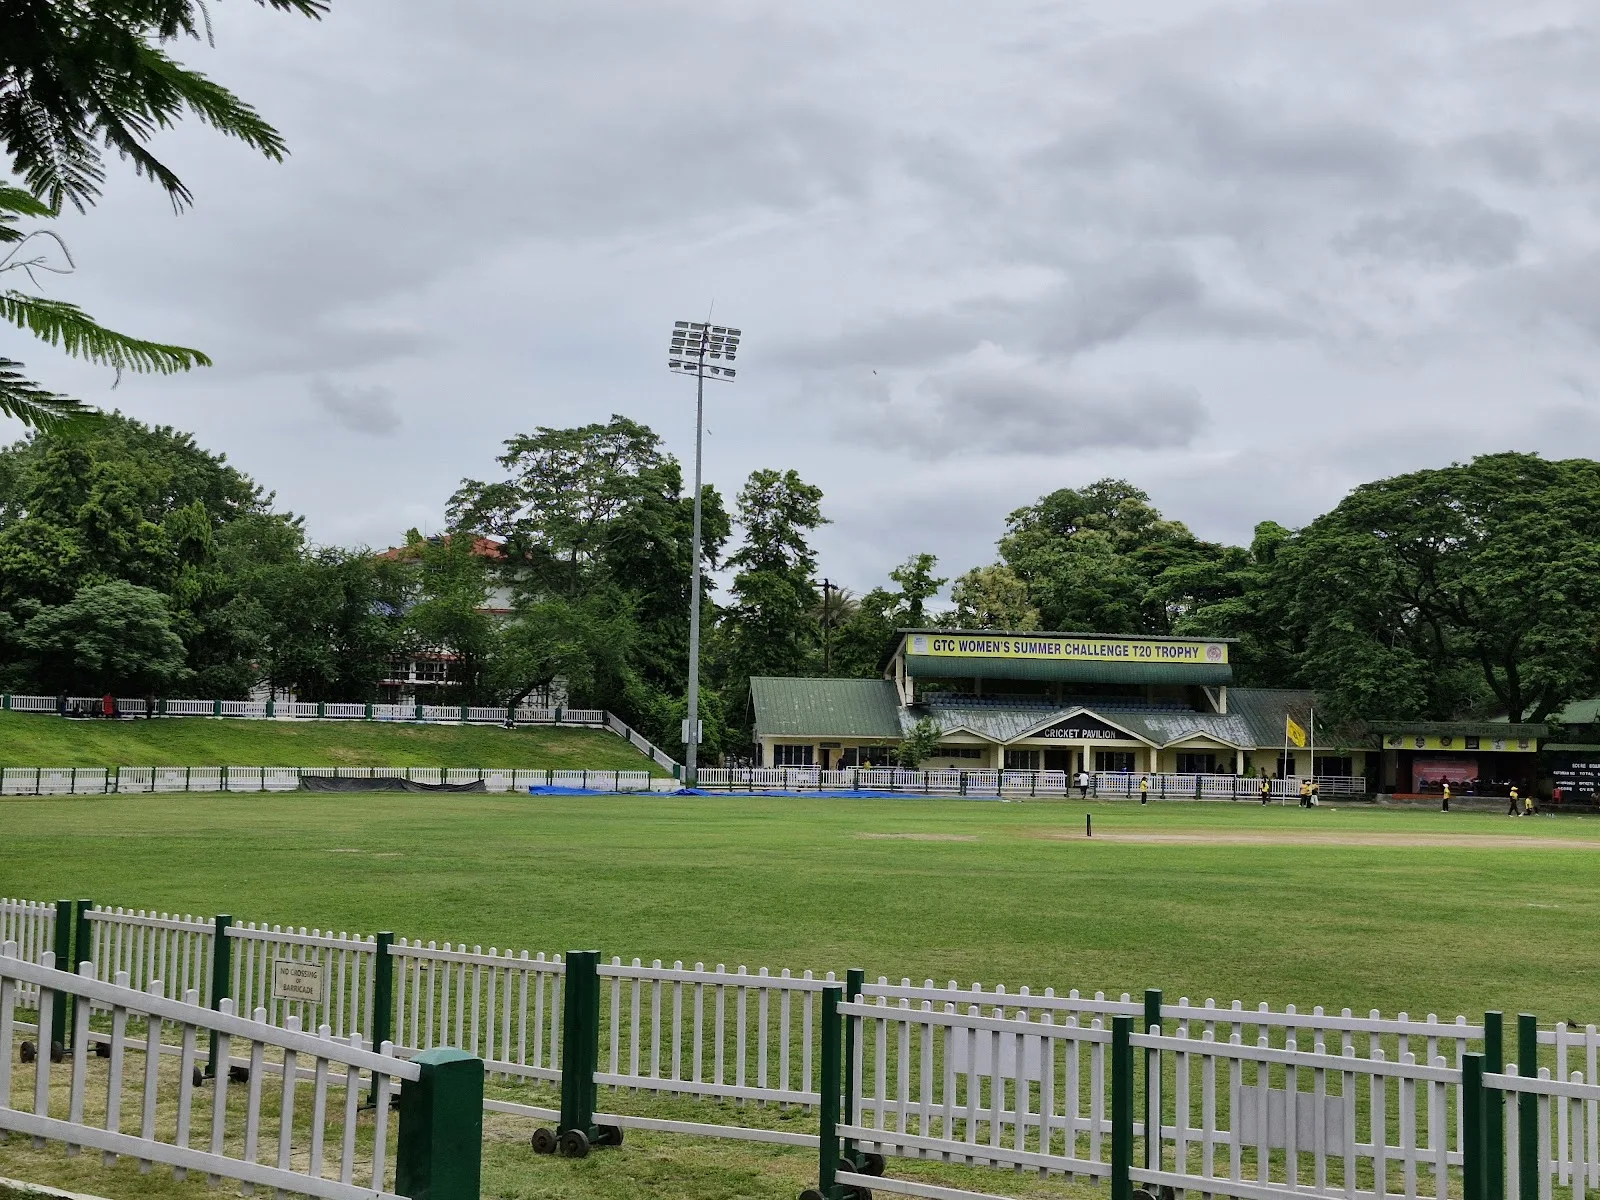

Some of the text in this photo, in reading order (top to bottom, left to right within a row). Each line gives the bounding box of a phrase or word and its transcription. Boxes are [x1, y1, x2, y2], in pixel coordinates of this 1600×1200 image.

[933, 639, 955, 652] GTC
[959, 640, 1010, 653] WOMEN'S
[1013, 641, 1061, 655] SUMMER
[1064, 643, 1129, 657] CHALLENGE
[1132, 645, 1152, 658] T20
[1154, 645, 1199, 659] TROPHY
[1044, 728, 1116, 738] CRICKET PAVILION
[290, 969, 317, 978] CROSSING
[283, 984, 313, 994] BARRICADE
